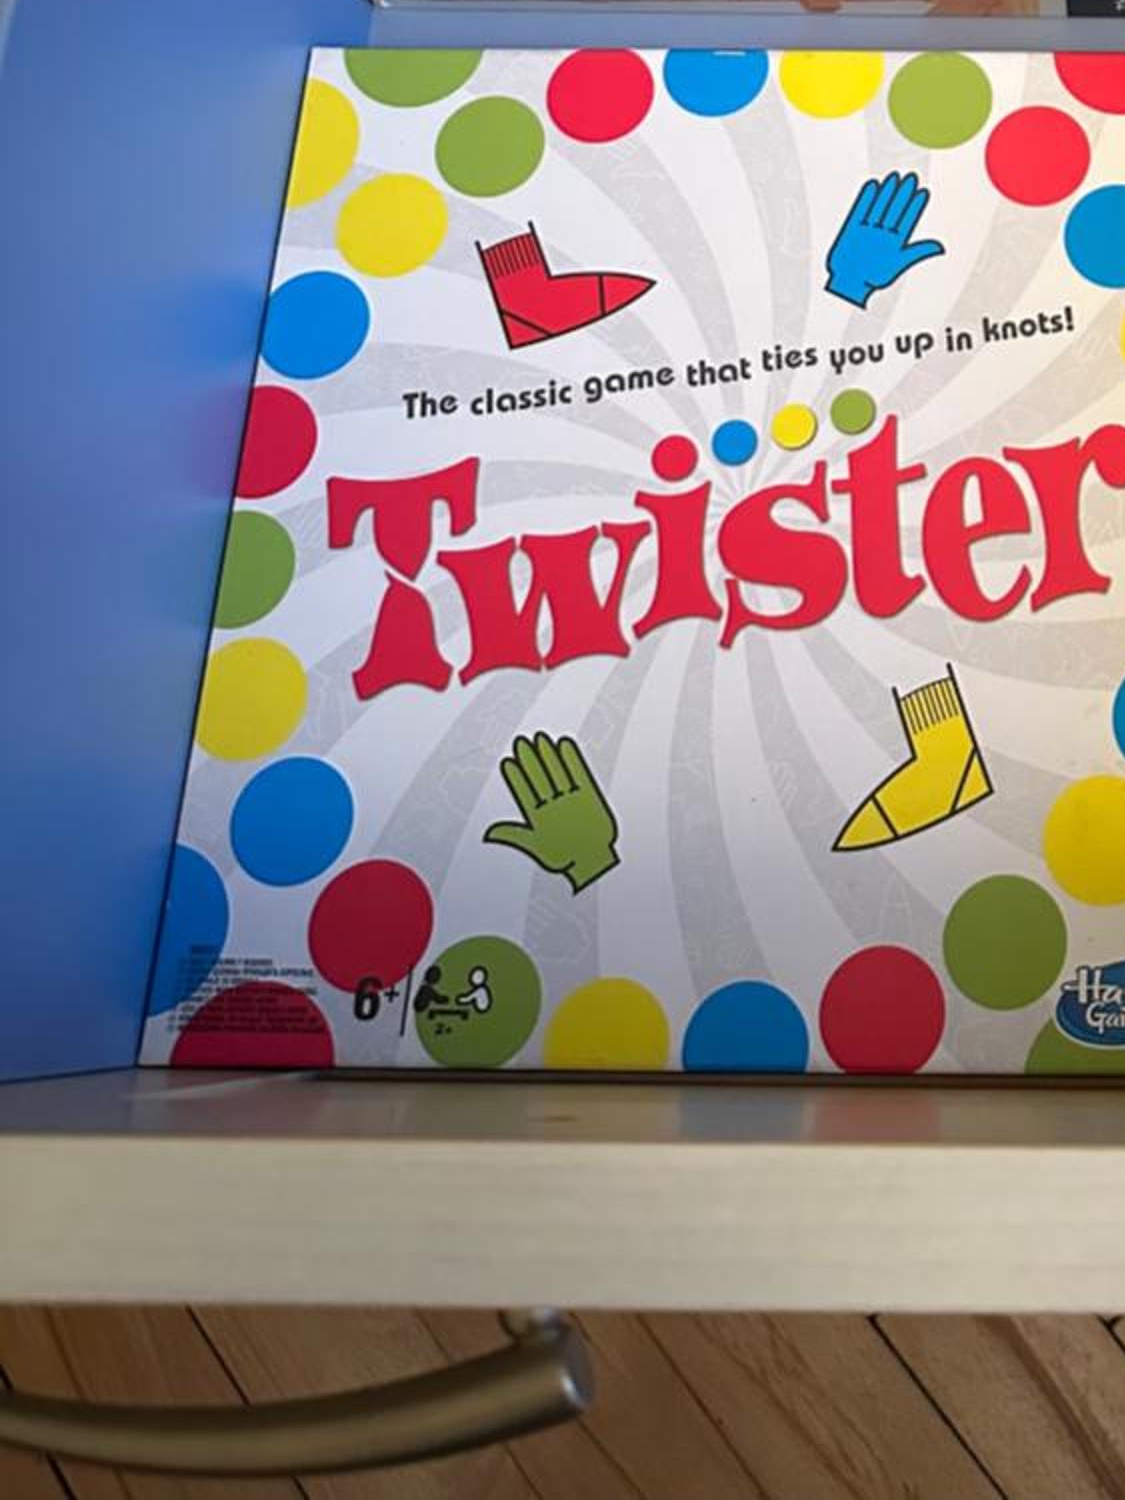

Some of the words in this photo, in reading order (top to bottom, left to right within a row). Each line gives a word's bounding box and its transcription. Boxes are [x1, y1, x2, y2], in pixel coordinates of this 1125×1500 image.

[402, 390, 458, 419] The
[469, 379, 573, 416] classic
[583, 366, 675, 404] game
[686, 358, 752, 387] that
[762, 344, 818, 372] ties
[829, 342, 884, 375] you
[895, 332, 934, 359] up
[945, 327, 972, 352] in
[982, 306, 1075, 343] knots!
